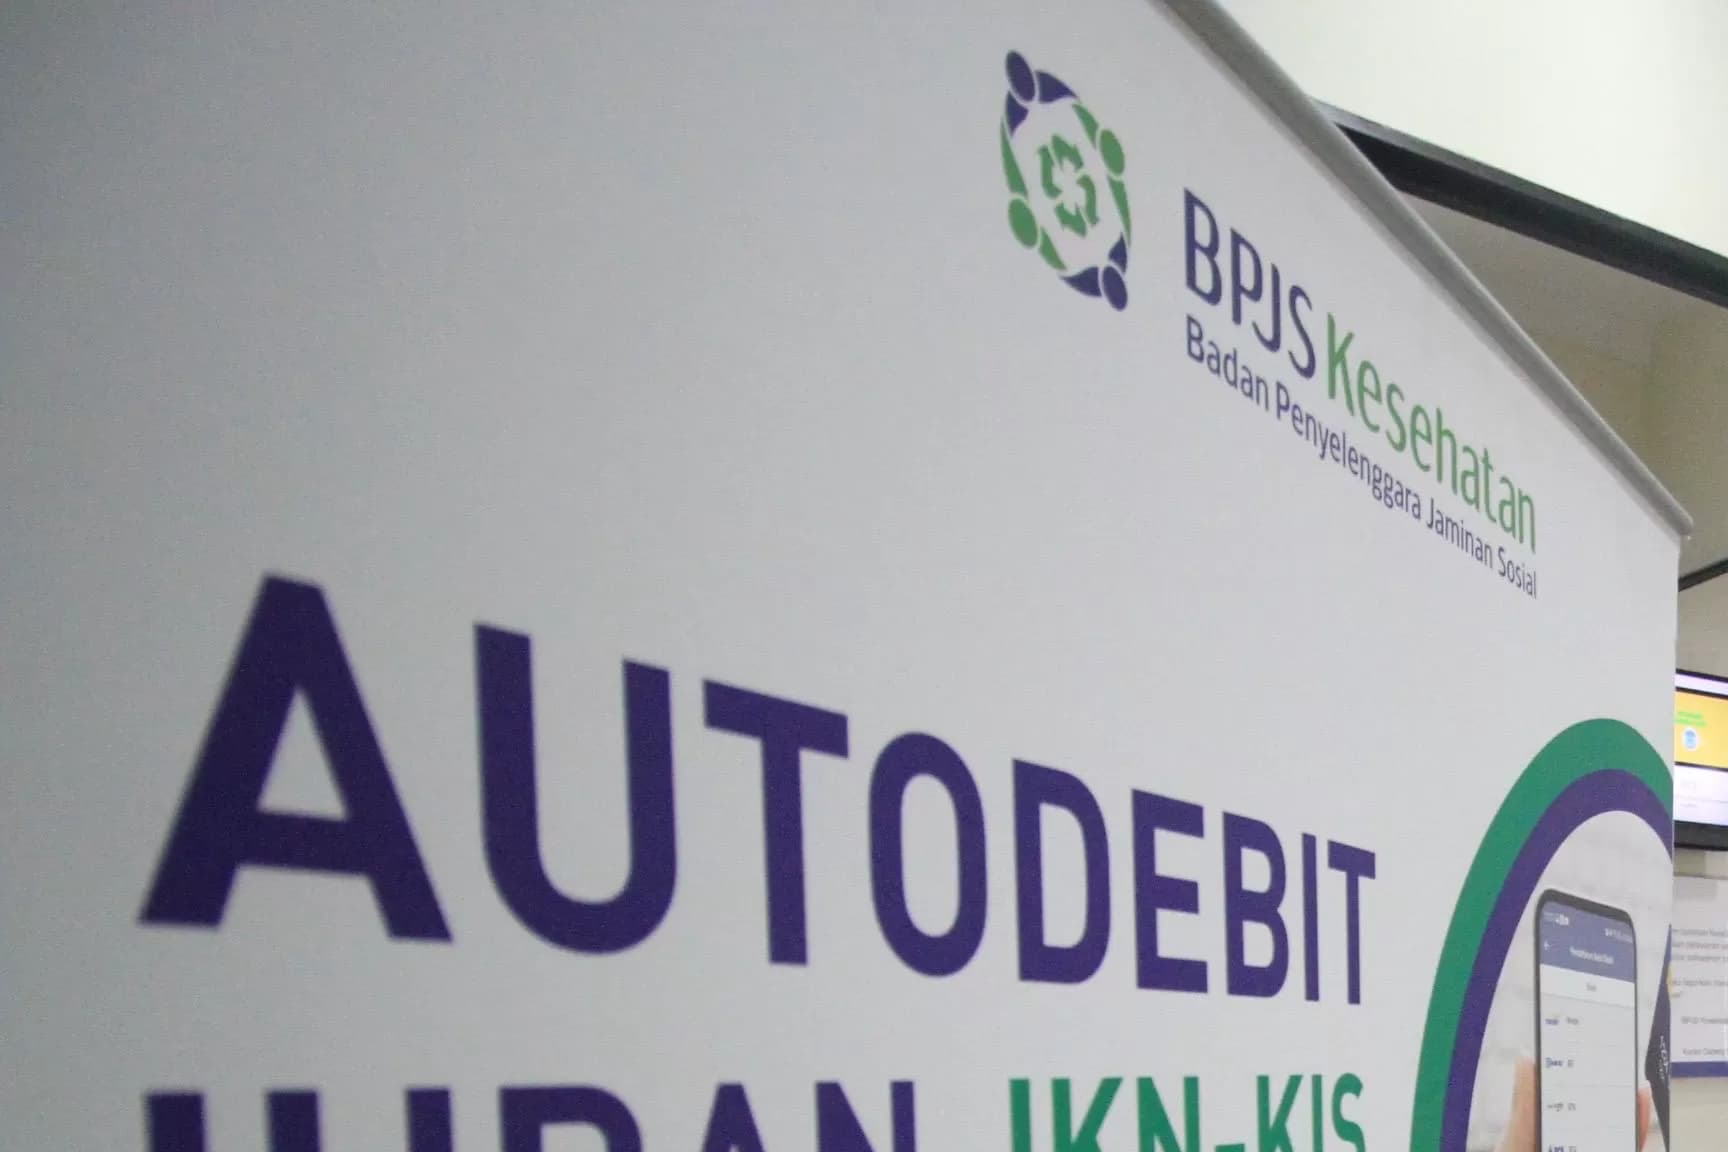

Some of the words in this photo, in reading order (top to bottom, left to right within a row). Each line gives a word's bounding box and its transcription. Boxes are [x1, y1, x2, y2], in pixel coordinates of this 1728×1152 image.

[1183, 186, 1316, 380] BPJS
[1326, 312, 1536, 554] Kesehatan
[1186, 313, 1269, 411] Badan
[1275, 380, 1422, 521] Penyelenggara
[1426, 497, 1493, 569] Jaminan
[1497, 547, 1537, 599] Sosial
[137, 571, 1376, 1005] AUTODEBIT
